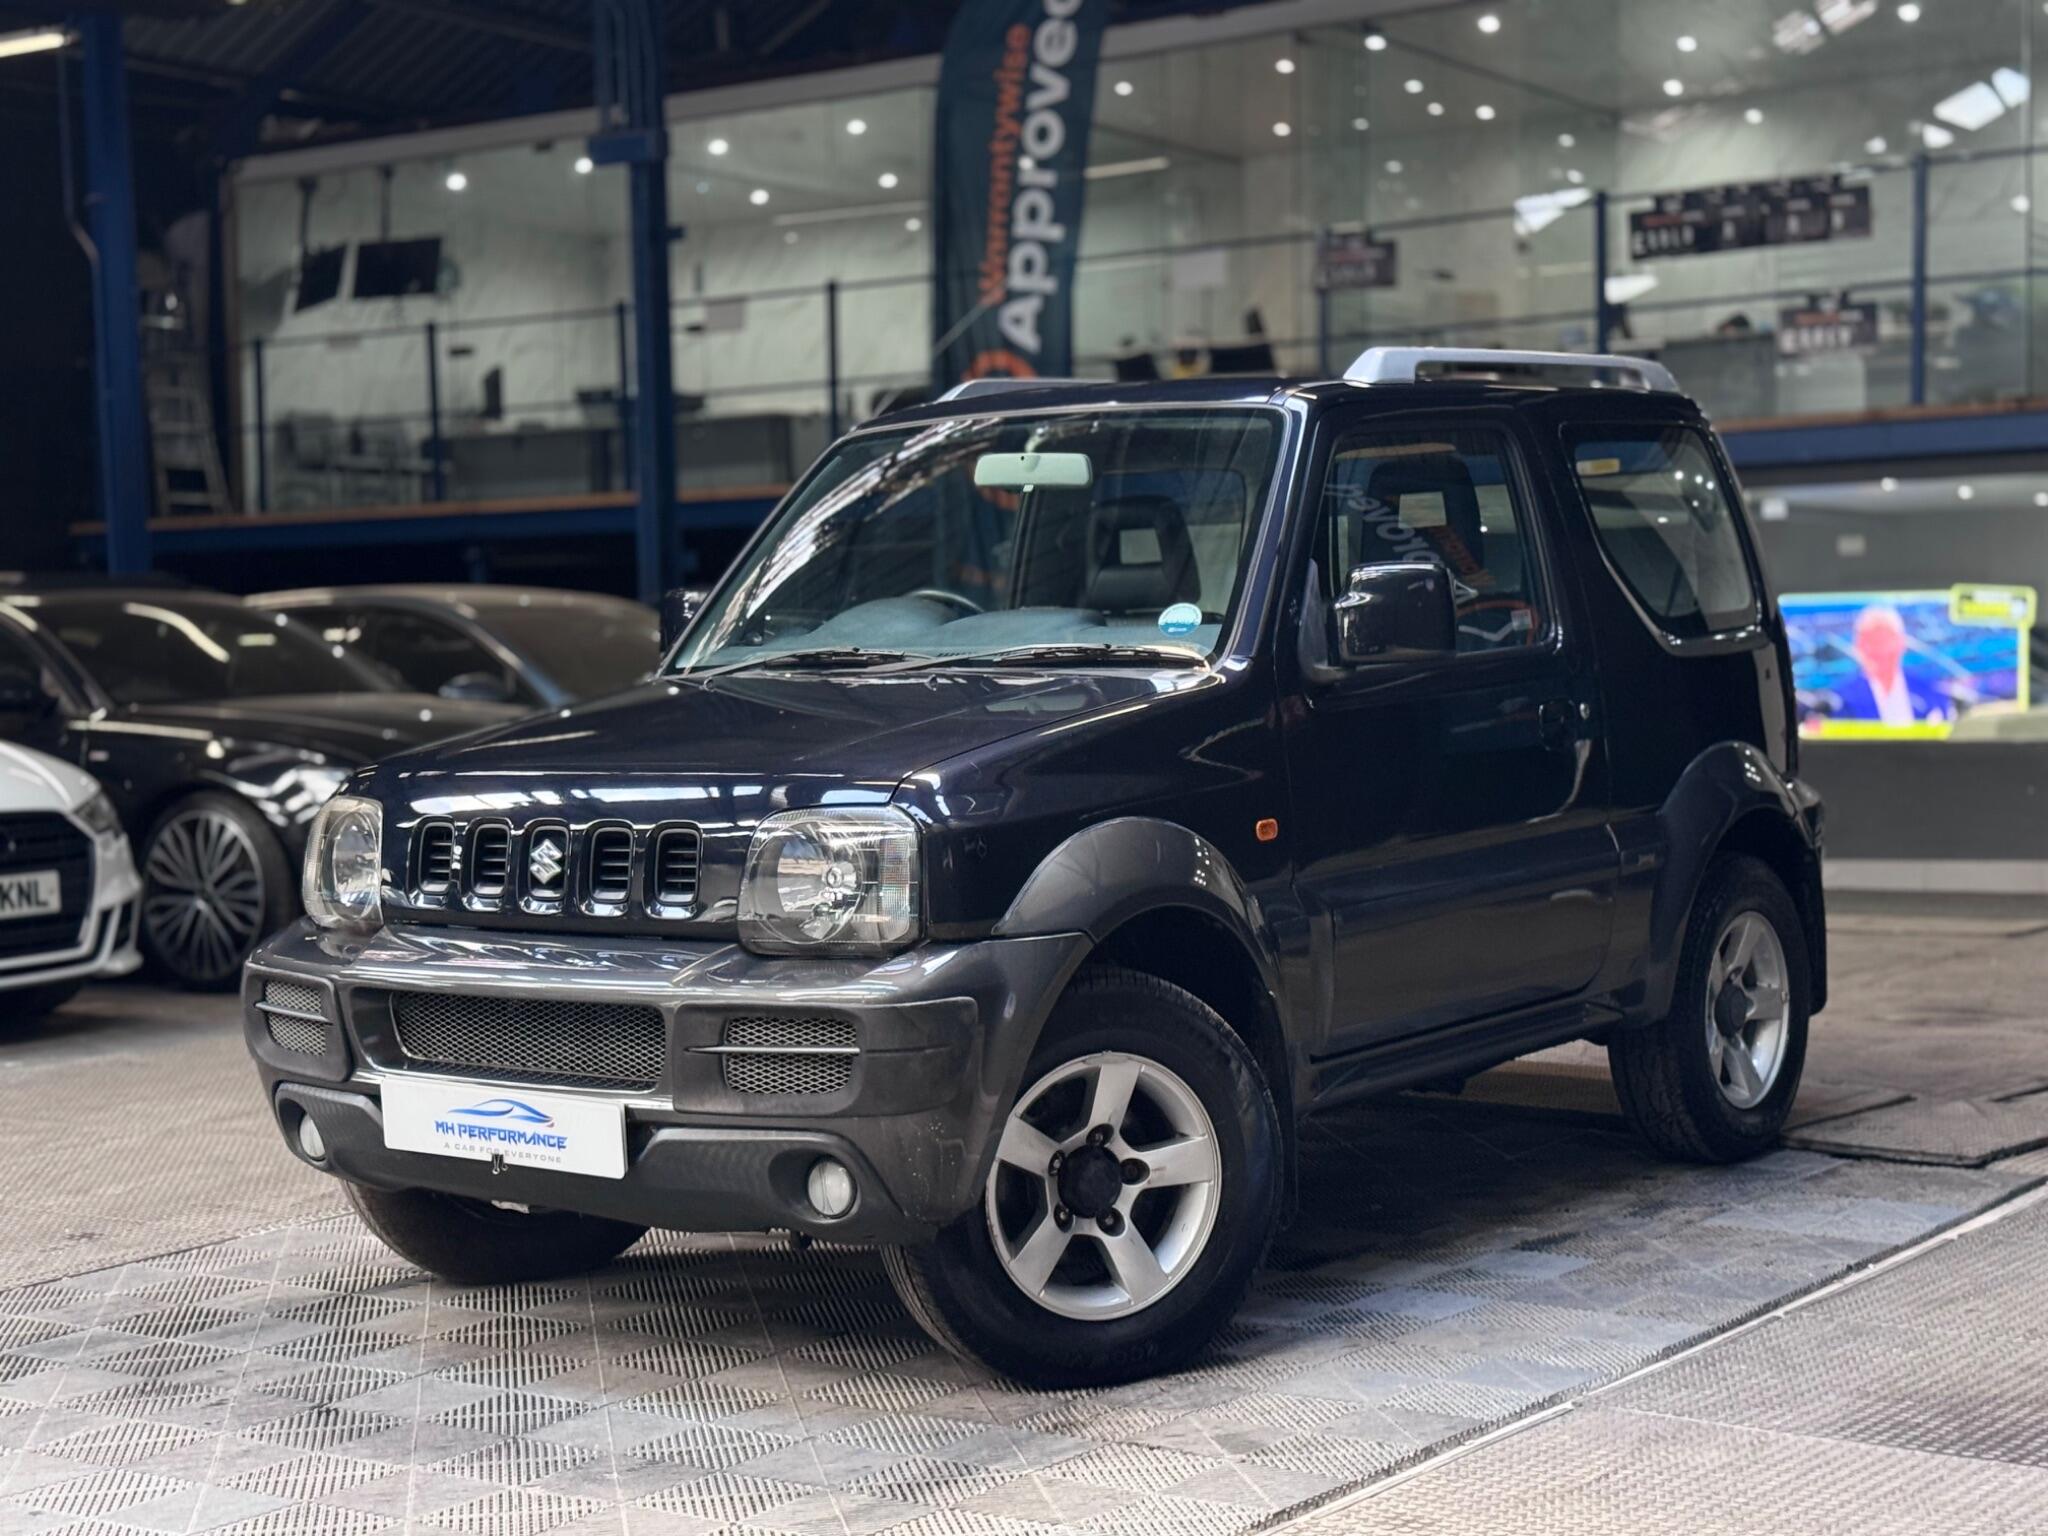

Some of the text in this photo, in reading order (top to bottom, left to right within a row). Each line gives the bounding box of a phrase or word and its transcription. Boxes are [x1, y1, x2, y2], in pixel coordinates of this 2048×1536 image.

[978, 22, 1031, 306] Warrantywise
[434, 1120, 568, 1150] MH PERFORMANCE
[454, 1143, 475, 1152] CAR
[479, 1146, 500, 1155] FOR
[504, 1150, 562, 1164] EVERYONE
